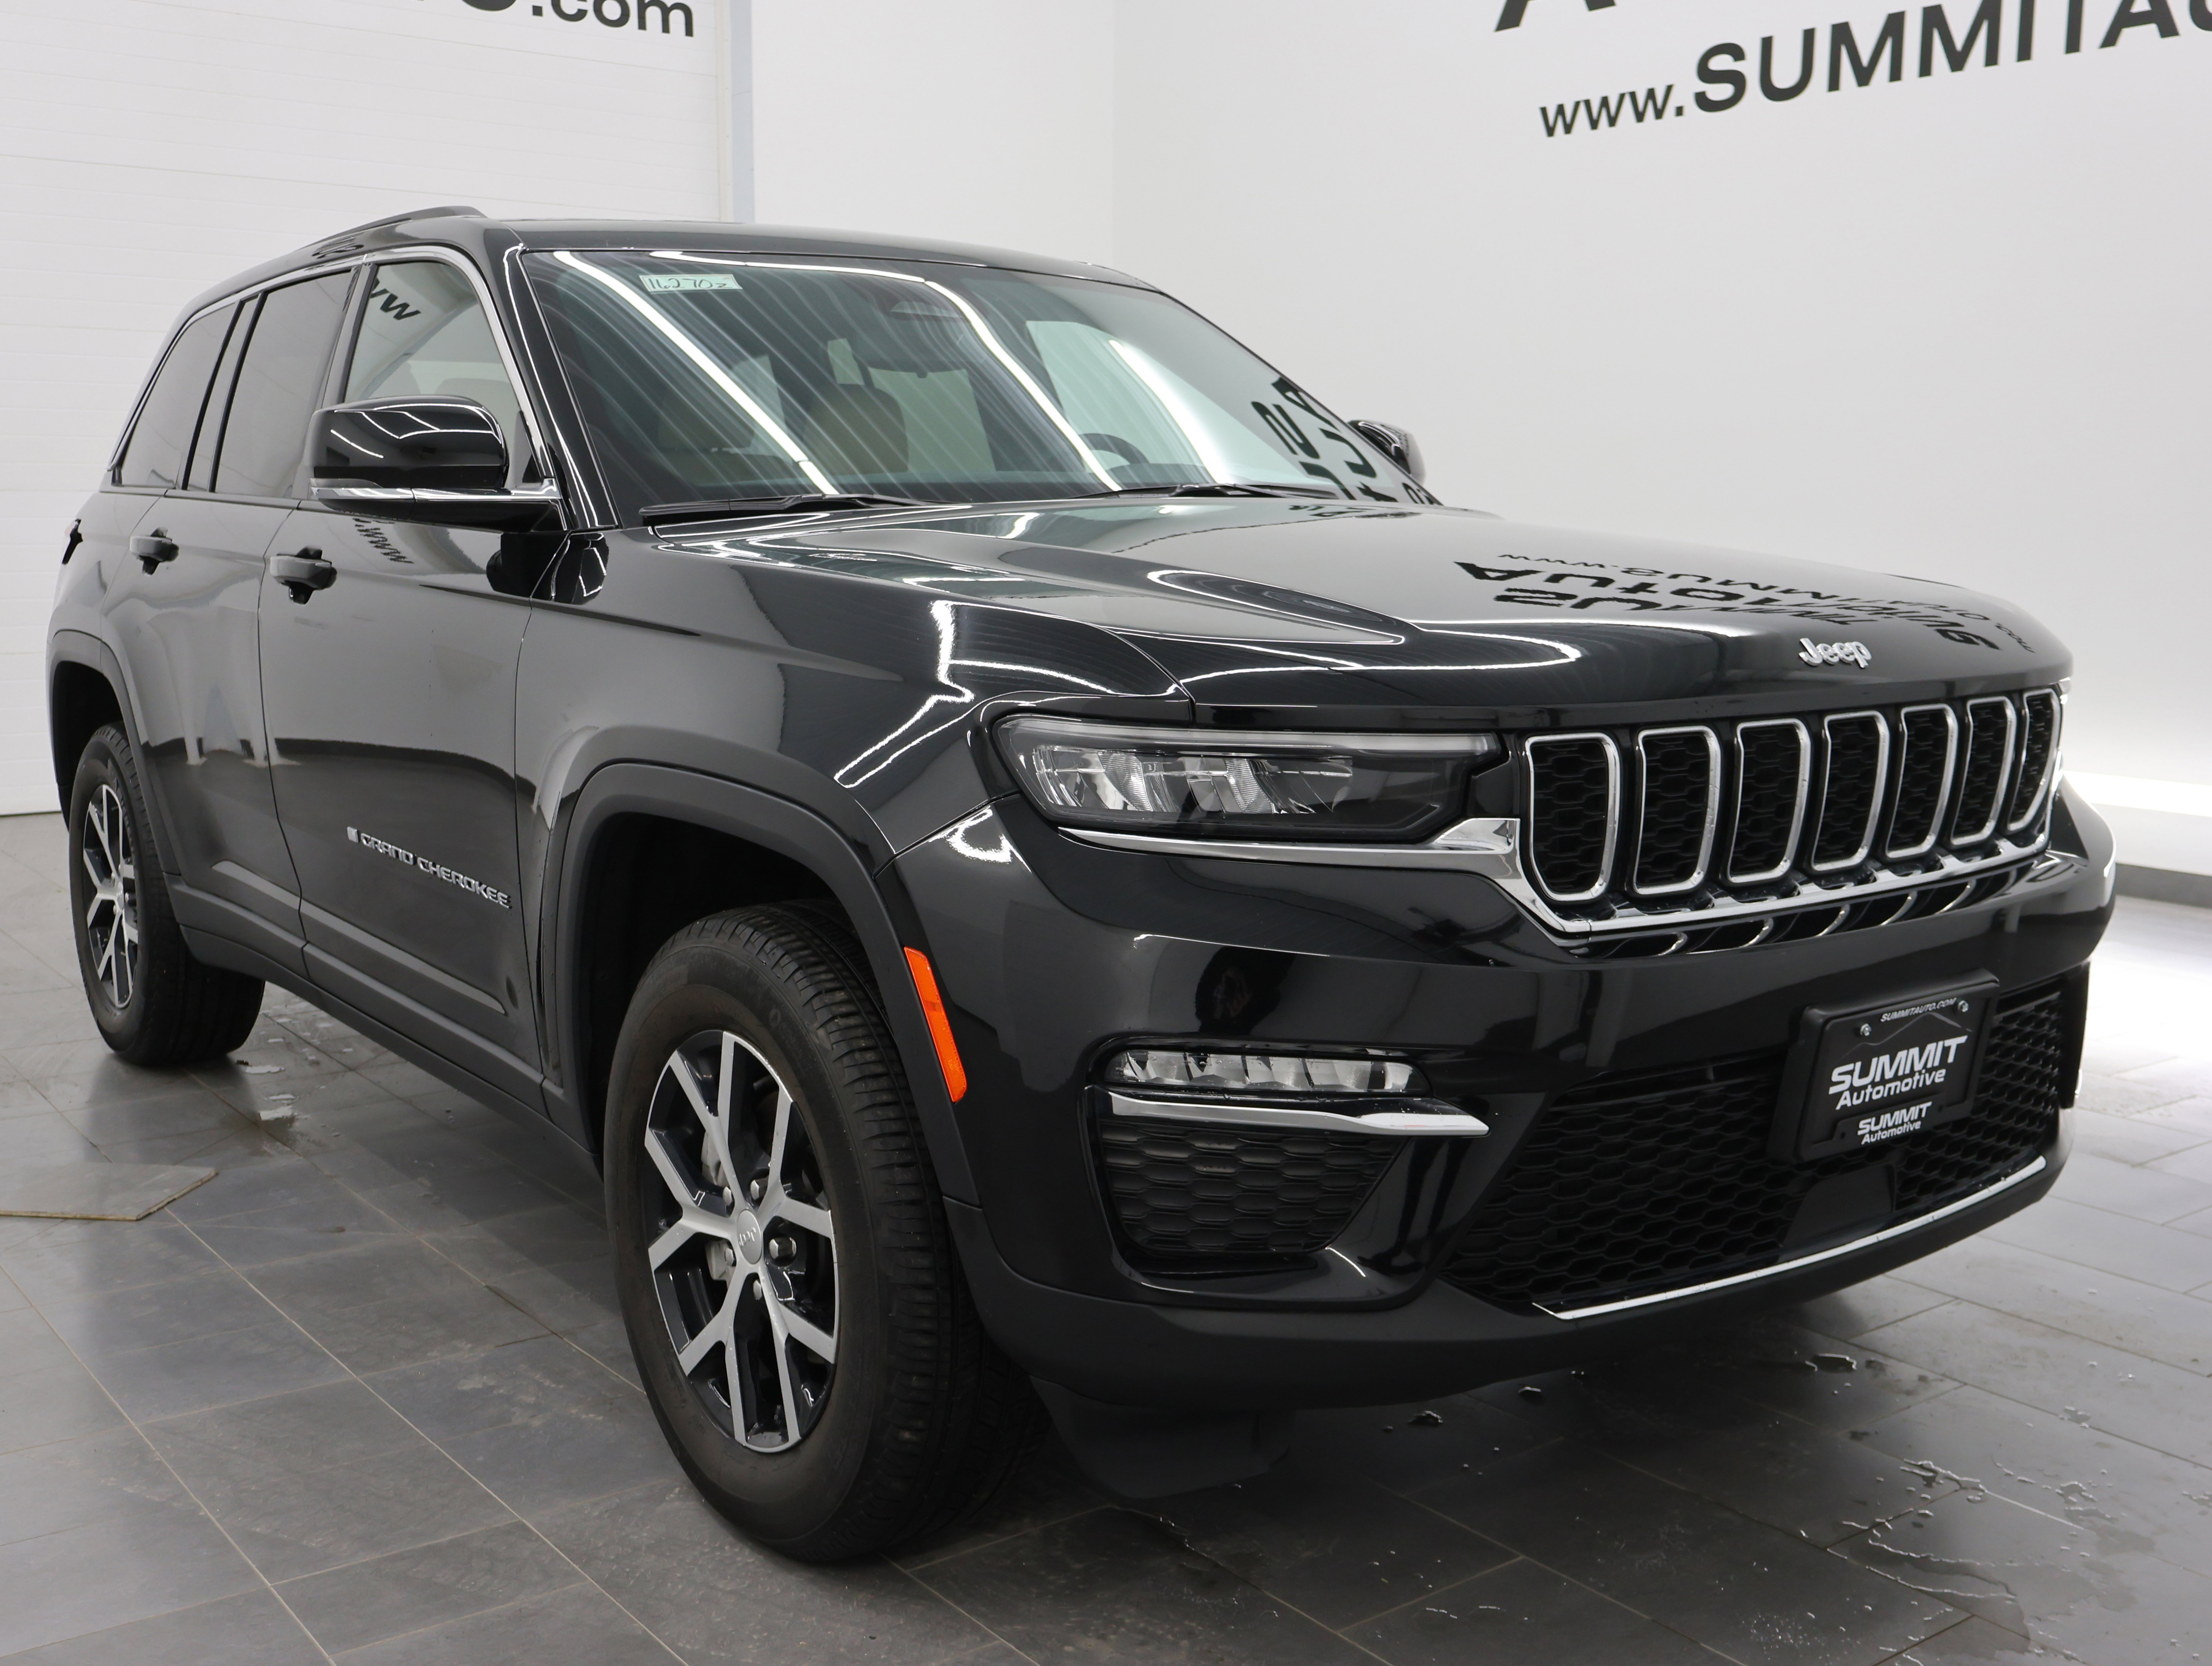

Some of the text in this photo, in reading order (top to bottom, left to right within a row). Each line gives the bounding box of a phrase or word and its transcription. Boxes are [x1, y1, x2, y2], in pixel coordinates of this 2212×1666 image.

[1799, 637, 1872, 669] Jeep
[361, 833, 512, 909] GRAND CHEROKEE
[1880, 997, 1957, 1022] SUMMITAUTO.COM
[1828, 1035, 1968, 1095] SUMMIT
[1836, 1068, 1946, 1110] Automotive
[1857, 1101, 1932, 1136] SUMMIT
[1861, 1120, 1921, 1145] Automotive
